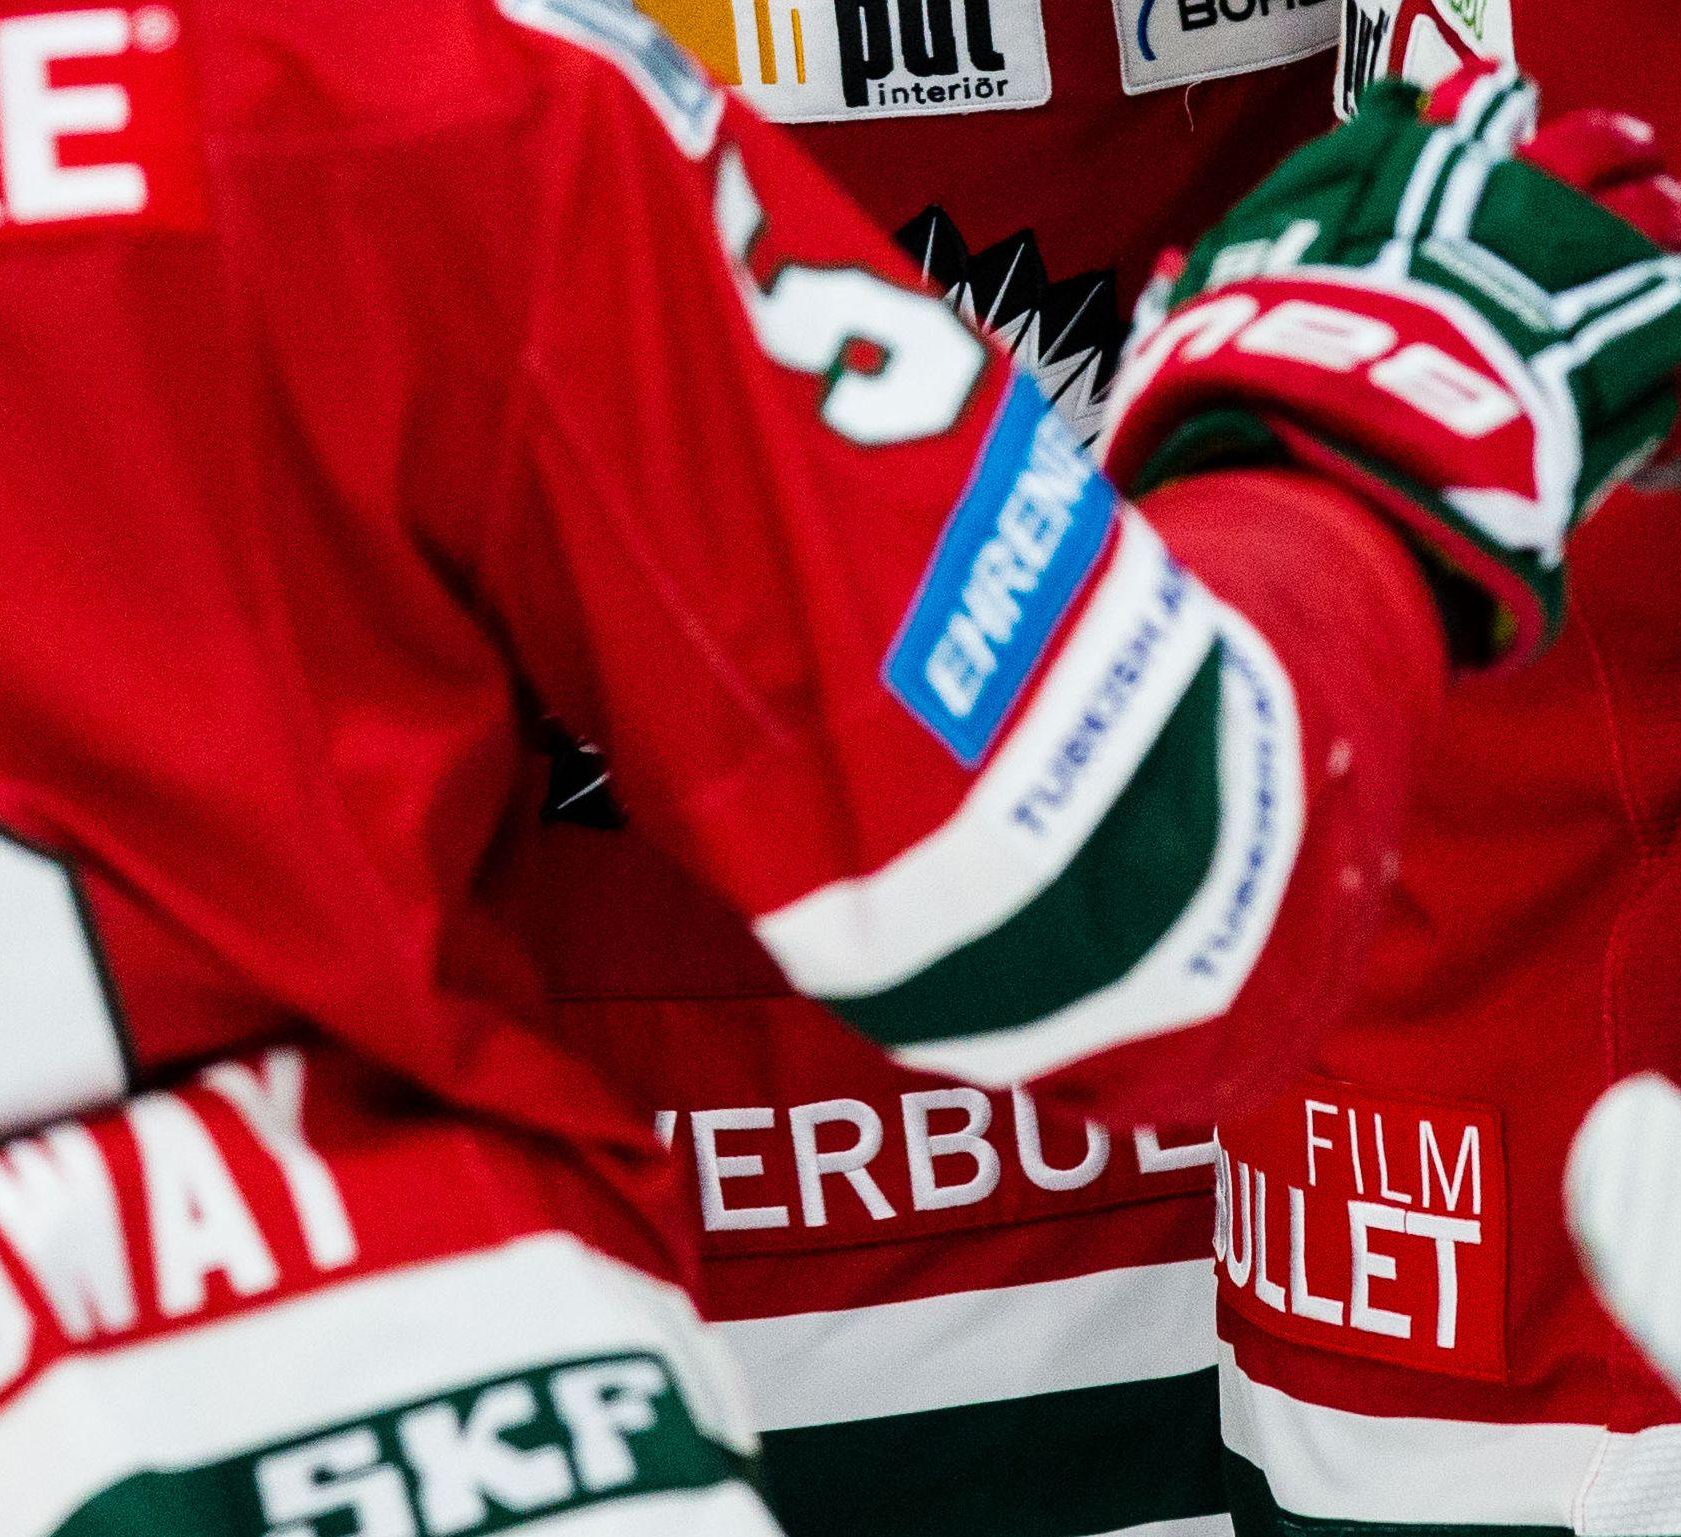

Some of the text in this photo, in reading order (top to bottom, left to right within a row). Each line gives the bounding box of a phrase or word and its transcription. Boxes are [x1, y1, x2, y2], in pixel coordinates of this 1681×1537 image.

[877, 75, 1010, 108] interiör
[1305, 1099, 1481, 1216] FILM
[254, 1354, 675, 1537] SKF
